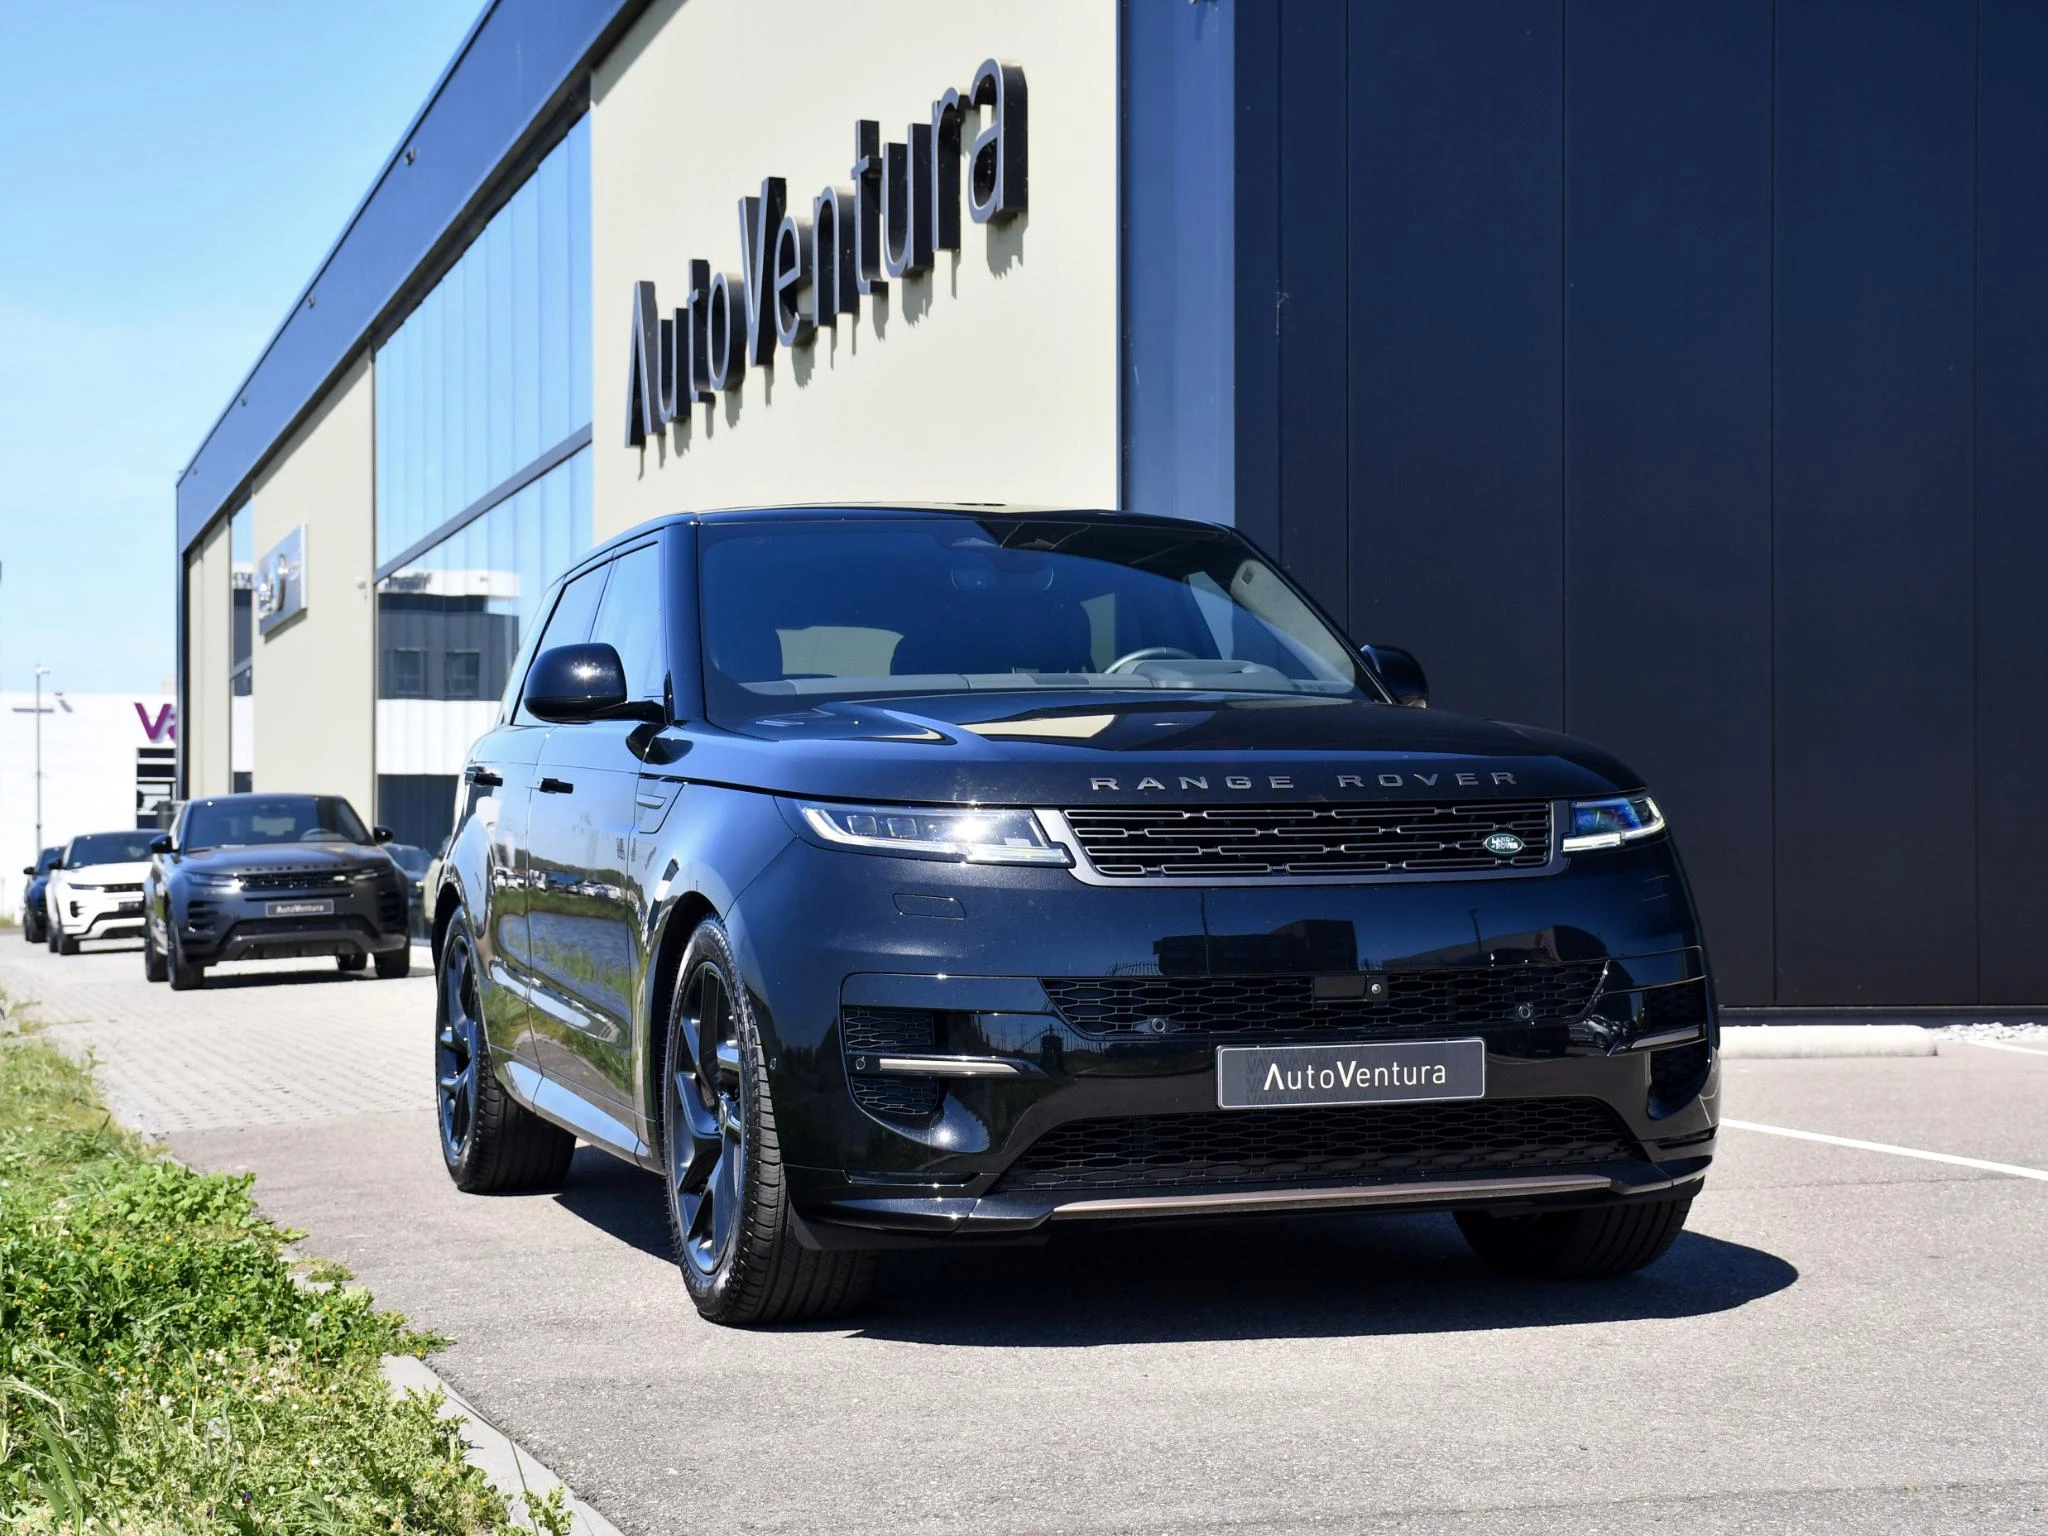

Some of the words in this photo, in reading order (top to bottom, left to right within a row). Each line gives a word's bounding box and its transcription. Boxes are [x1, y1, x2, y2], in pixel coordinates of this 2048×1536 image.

[624, 58, 1028, 448] AutoVentura
[1089, 775, 1294, 791] RANGE
[1336, 772, 1518, 788] ROVER
[1491, 836, 1511, 844] LAND
[1263, 1060, 1446, 1091] AutoVentura
